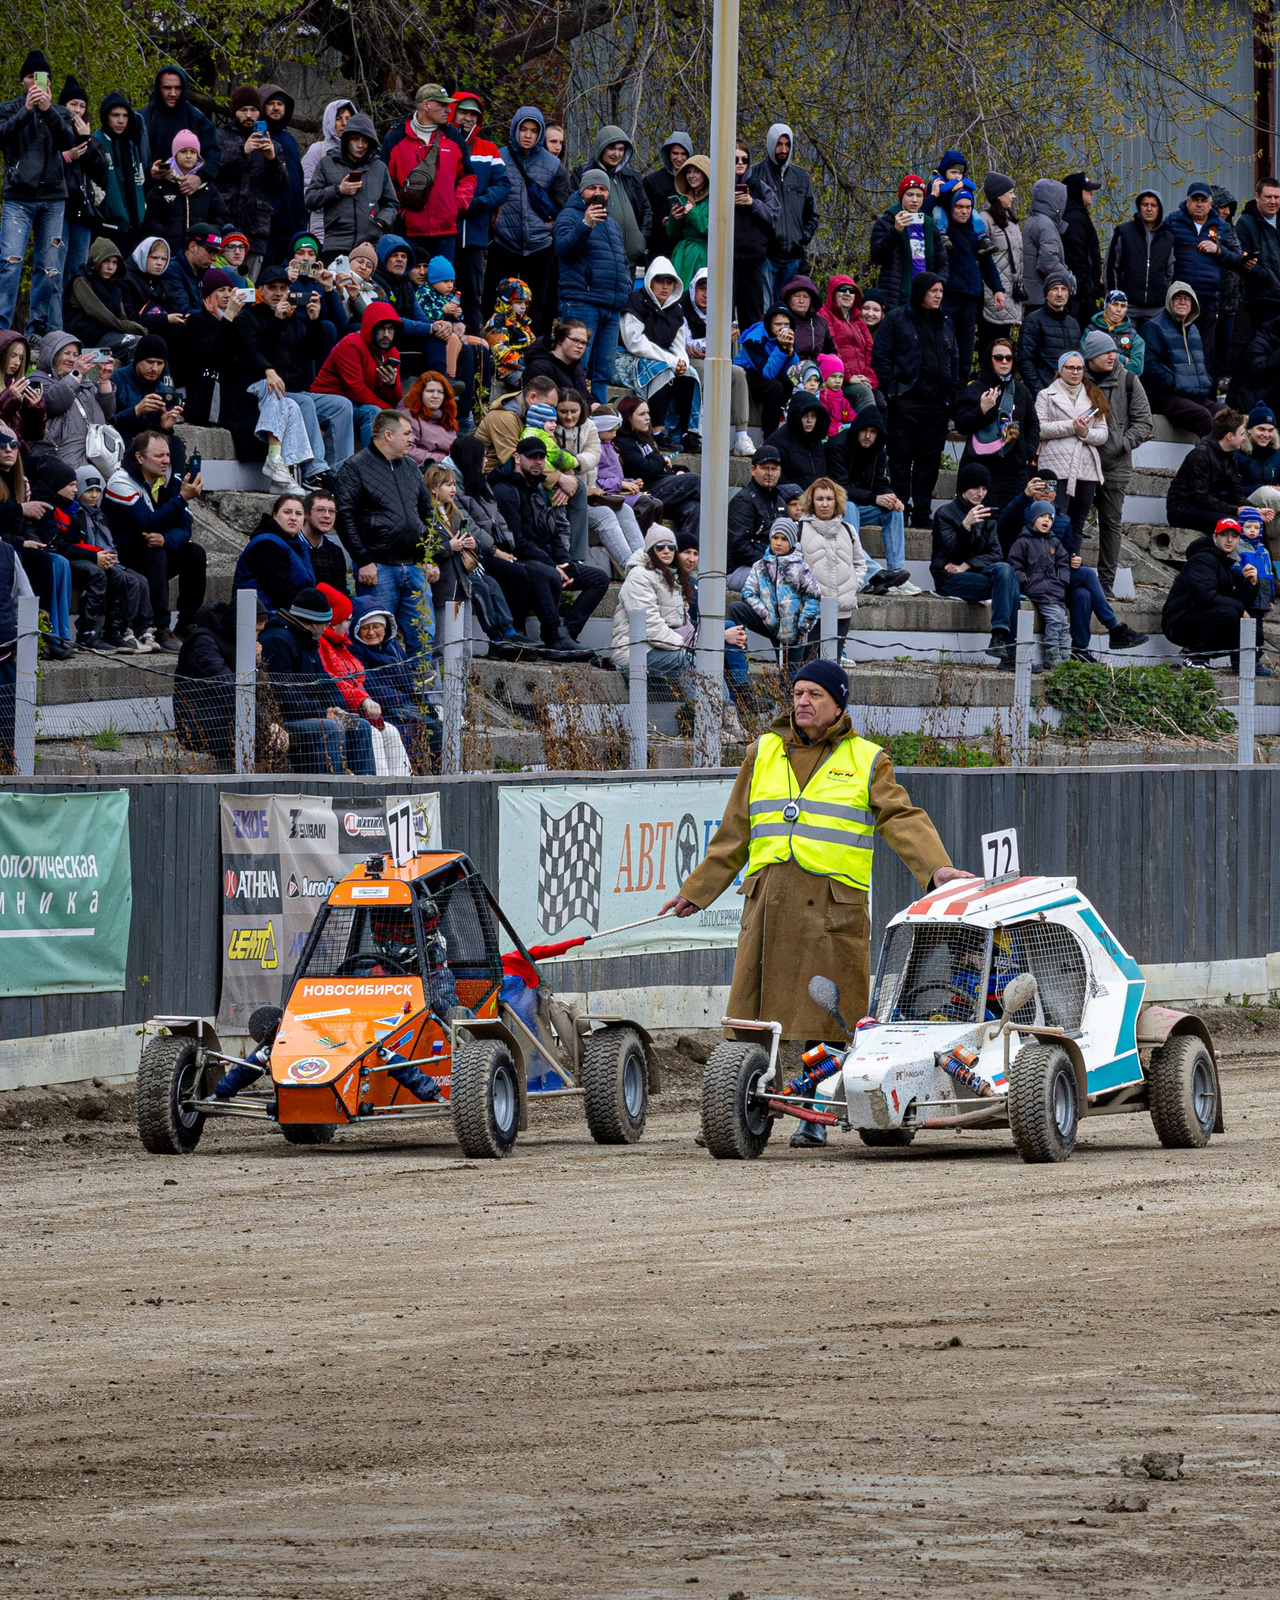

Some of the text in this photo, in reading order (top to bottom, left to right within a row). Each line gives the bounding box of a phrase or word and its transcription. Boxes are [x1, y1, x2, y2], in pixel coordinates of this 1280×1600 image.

[233, 809, 269, 839] EXIDE
[388, 805, 410, 859] 77
[987, 836, 1014, 878] 72
[236, 870, 280, 899] ATHENA
[1098, 930, 1117, 956] 72
[302, 984, 413, 998] НОВОСИБИРСК
